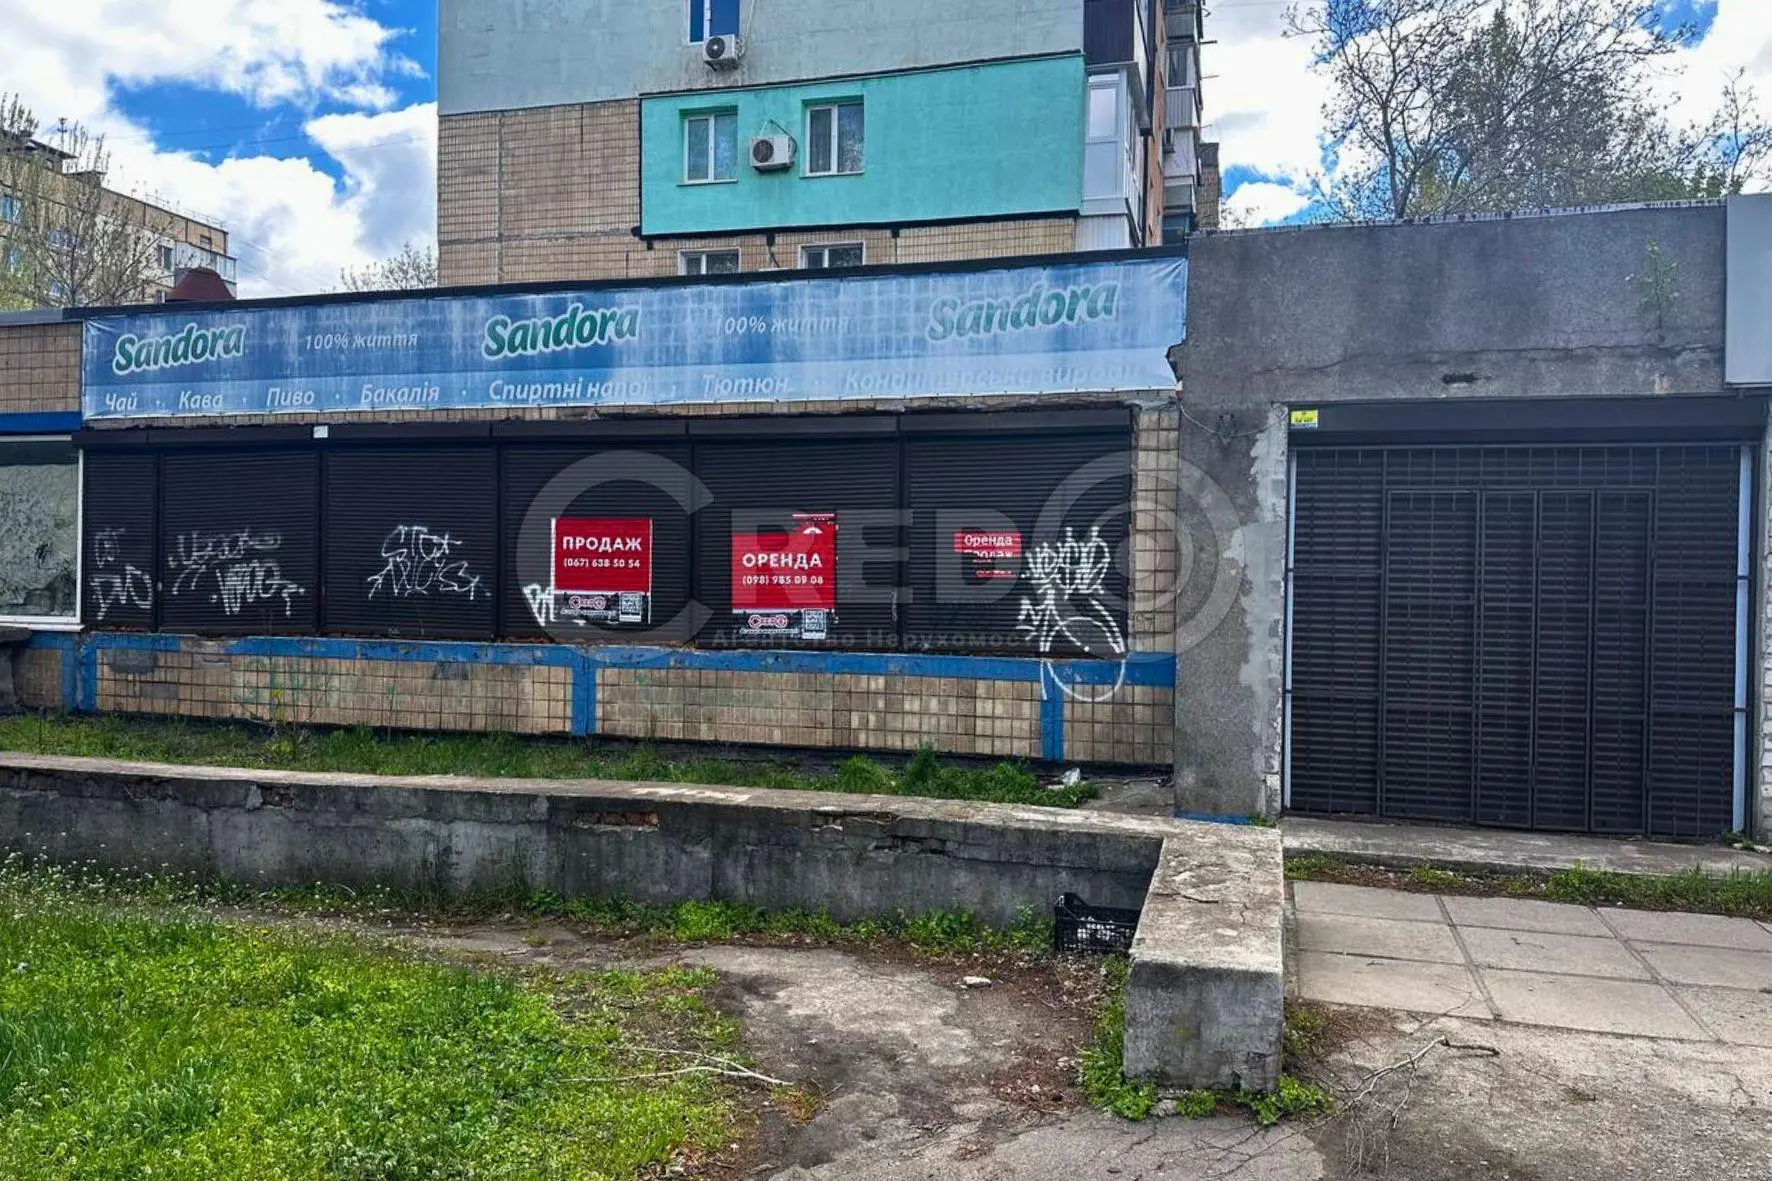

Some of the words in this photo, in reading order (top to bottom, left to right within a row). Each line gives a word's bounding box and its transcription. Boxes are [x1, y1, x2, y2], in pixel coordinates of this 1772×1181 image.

[926, 279, 1120, 343] Sandora
[481, 303, 641, 361] Sandora
[716, 316, 766, 335] 100%
[112, 322, 247, 375] Sandora
[305, 334, 349, 351] 100%
[351, 332, 418, 348] життя
[105, 392, 137, 412] Чай
[179, 390, 223, 410] Кава
[267, 387, 314, 406] Пиво
[361, 381, 440, 404] Бакалія
[489, 376, 583, 400] Спиртні
[702, 373, 788, 395] Тютюн
[562, 536, 642, 552] ПРОДАЖ
[964, 534, 1013, 546] Оренда
[564, 558, 589, 568] (067)
[592, 558, 609, 568] 638
[612, 558, 625, 568] 50
[628, 558, 640, 568] 54
[742, 553, 822, 569] ОРЕНДА
[742, 575, 769, 585] (098)
[772, 575, 791, 585] 985
[794, 575, 807, 585] 09
[810, 575, 824, 585] 08
